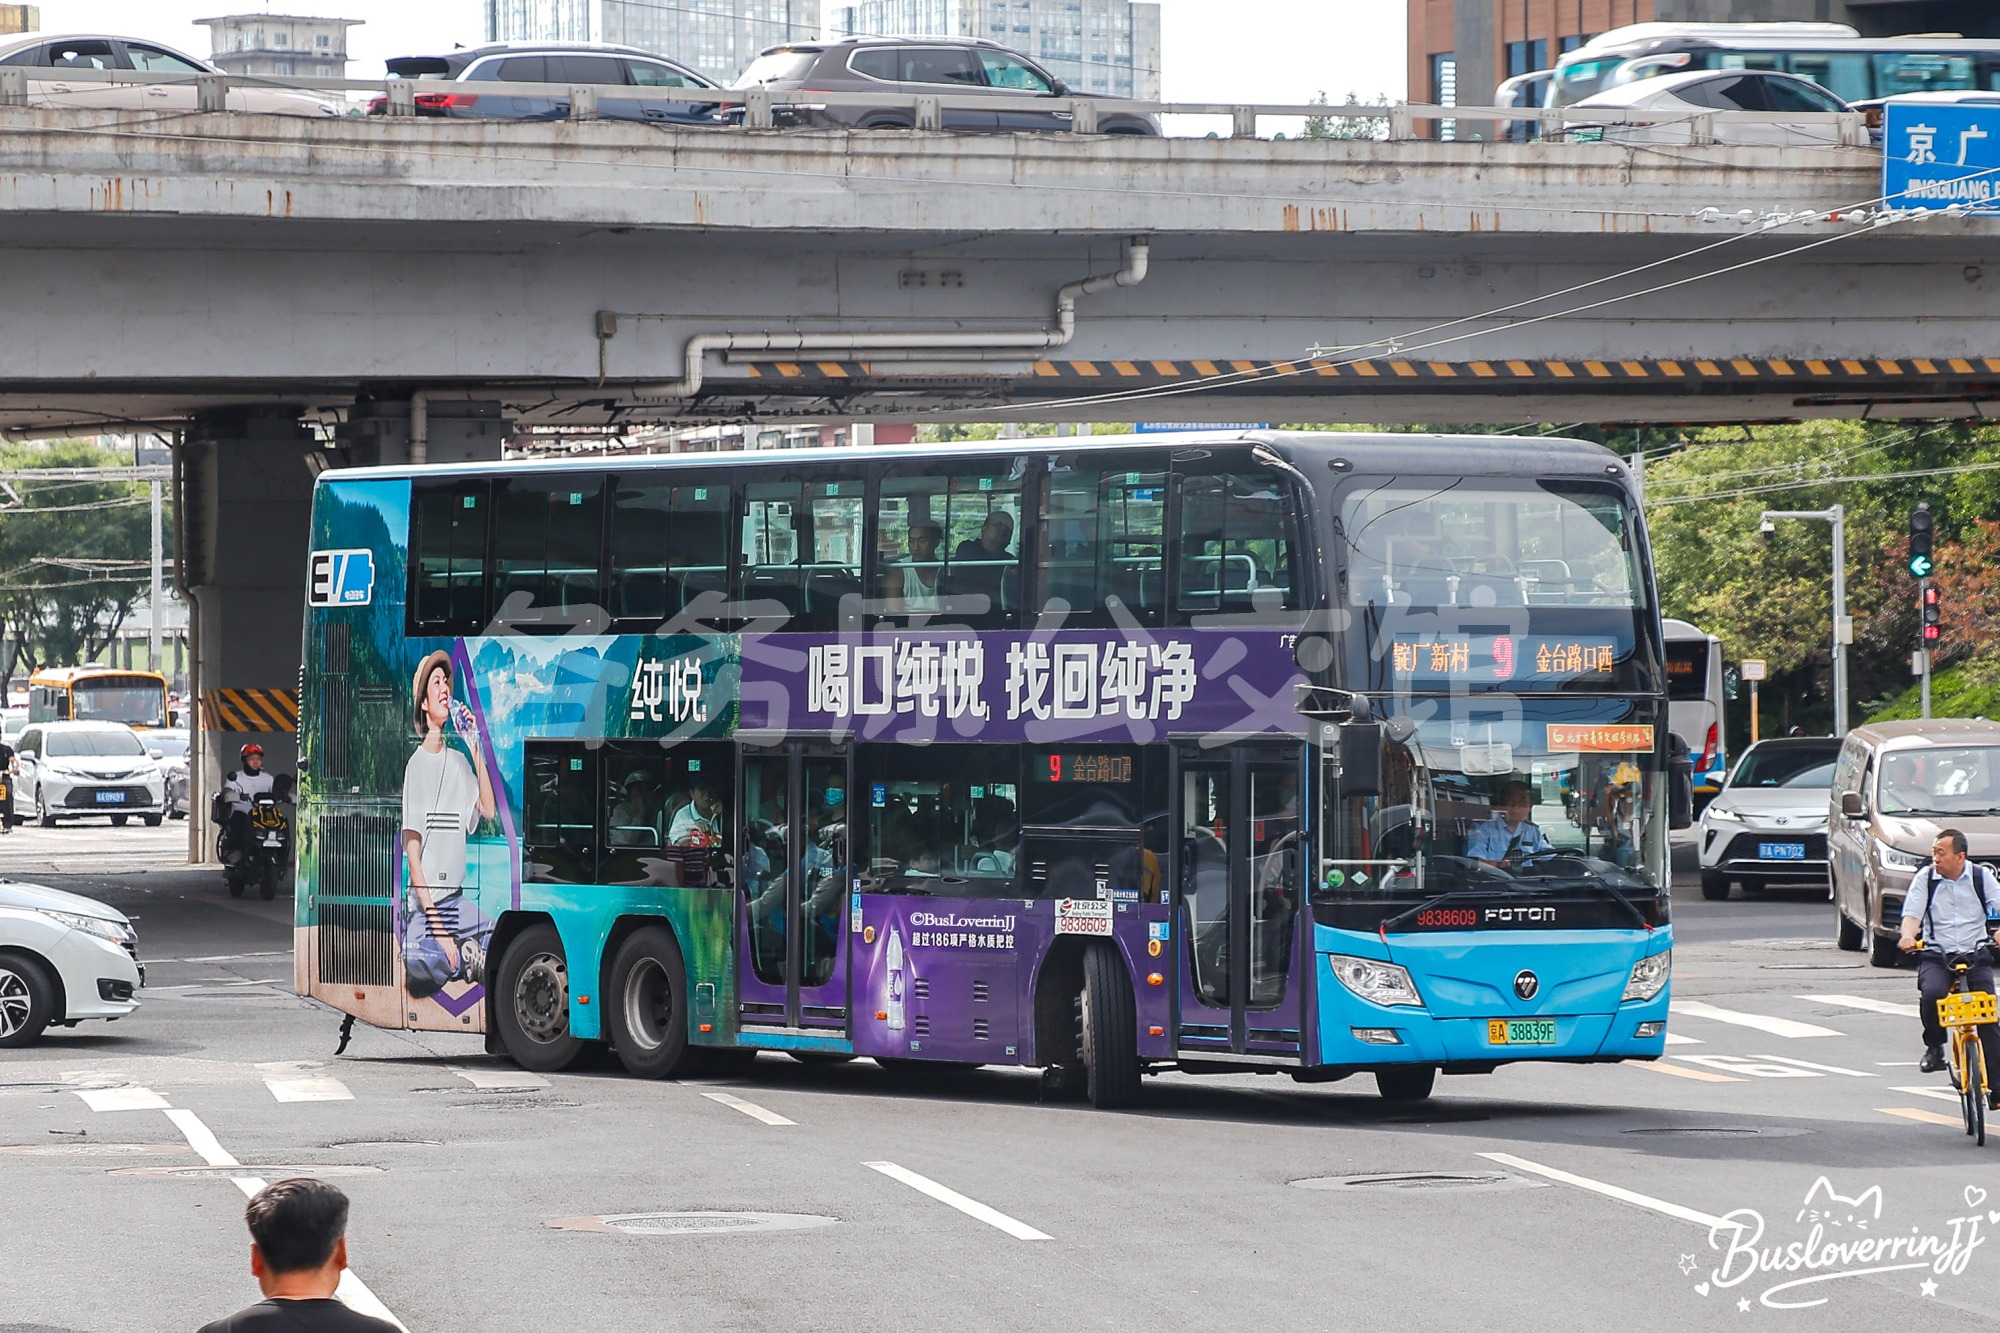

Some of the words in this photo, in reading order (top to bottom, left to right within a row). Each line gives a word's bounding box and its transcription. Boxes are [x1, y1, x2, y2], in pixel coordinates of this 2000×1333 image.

[1906, 123, 1988, 166] 京广
[1904, 178, 1990, 199] JINGGUANG
[1492, 637, 1513, 677] 9
[1535, 643, 1613, 673] 金台路口西
[630, 657, 702, 722] 纯悦
[1005, 640, 1198, 720] 找回纯净
[1050, 754, 1061, 781] 9
[1072, 901, 1108, 910] 北京公交
[1061, 917, 1107, 932] 9838609
[1417, 909, 1477, 926] 9838609
[1485, 907, 1556, 922] FOTON
[912, 931, 1014, 949] 超过186项严格水质把控
[1511, 1023, 1554, 1041] 38839F
